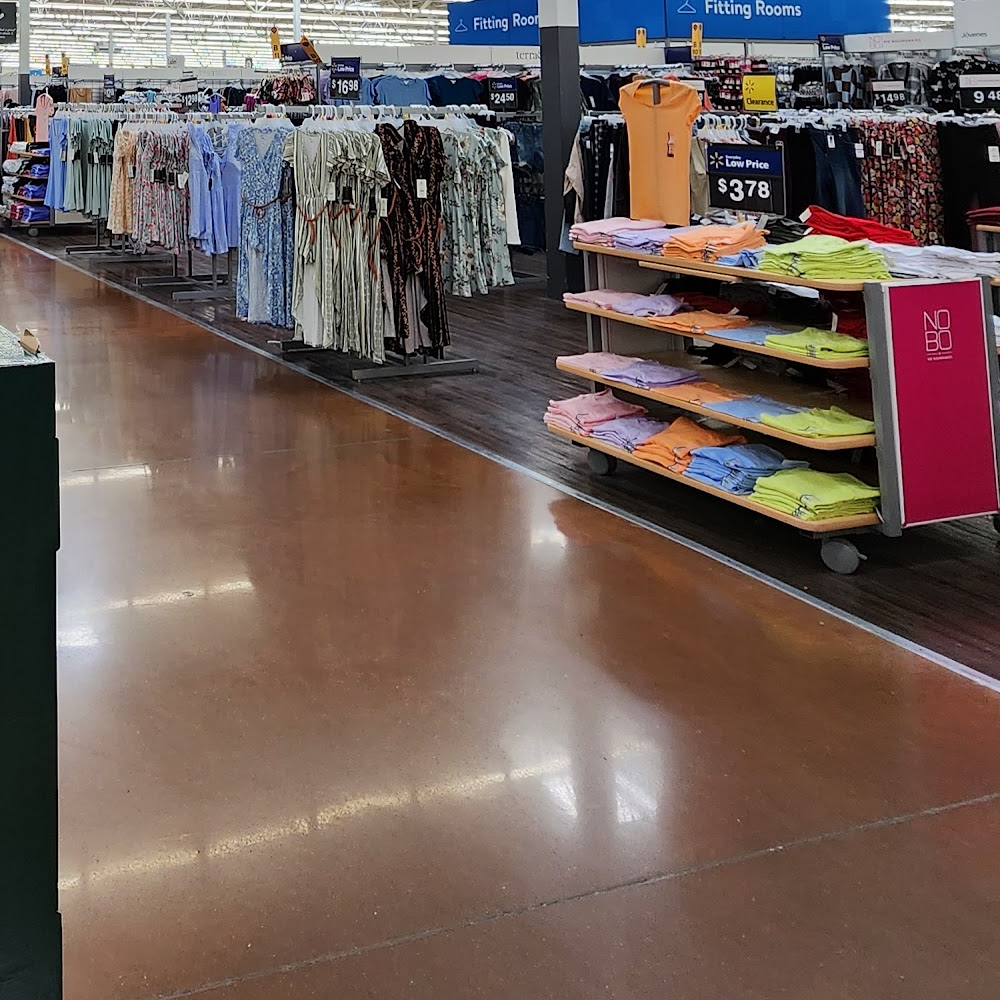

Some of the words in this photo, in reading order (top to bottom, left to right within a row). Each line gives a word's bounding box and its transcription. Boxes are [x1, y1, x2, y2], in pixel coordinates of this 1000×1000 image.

[756, 0, 802, 17] Rooms
[473, 16, 508, 32] Fitting
[746, 97, 775, 107] Clearance
[725, 158, 745, 168] Low
[746, 159, 770, 170] Price
[923, 309, 951, 331] NO
[925, 330, 953, 352] BO
